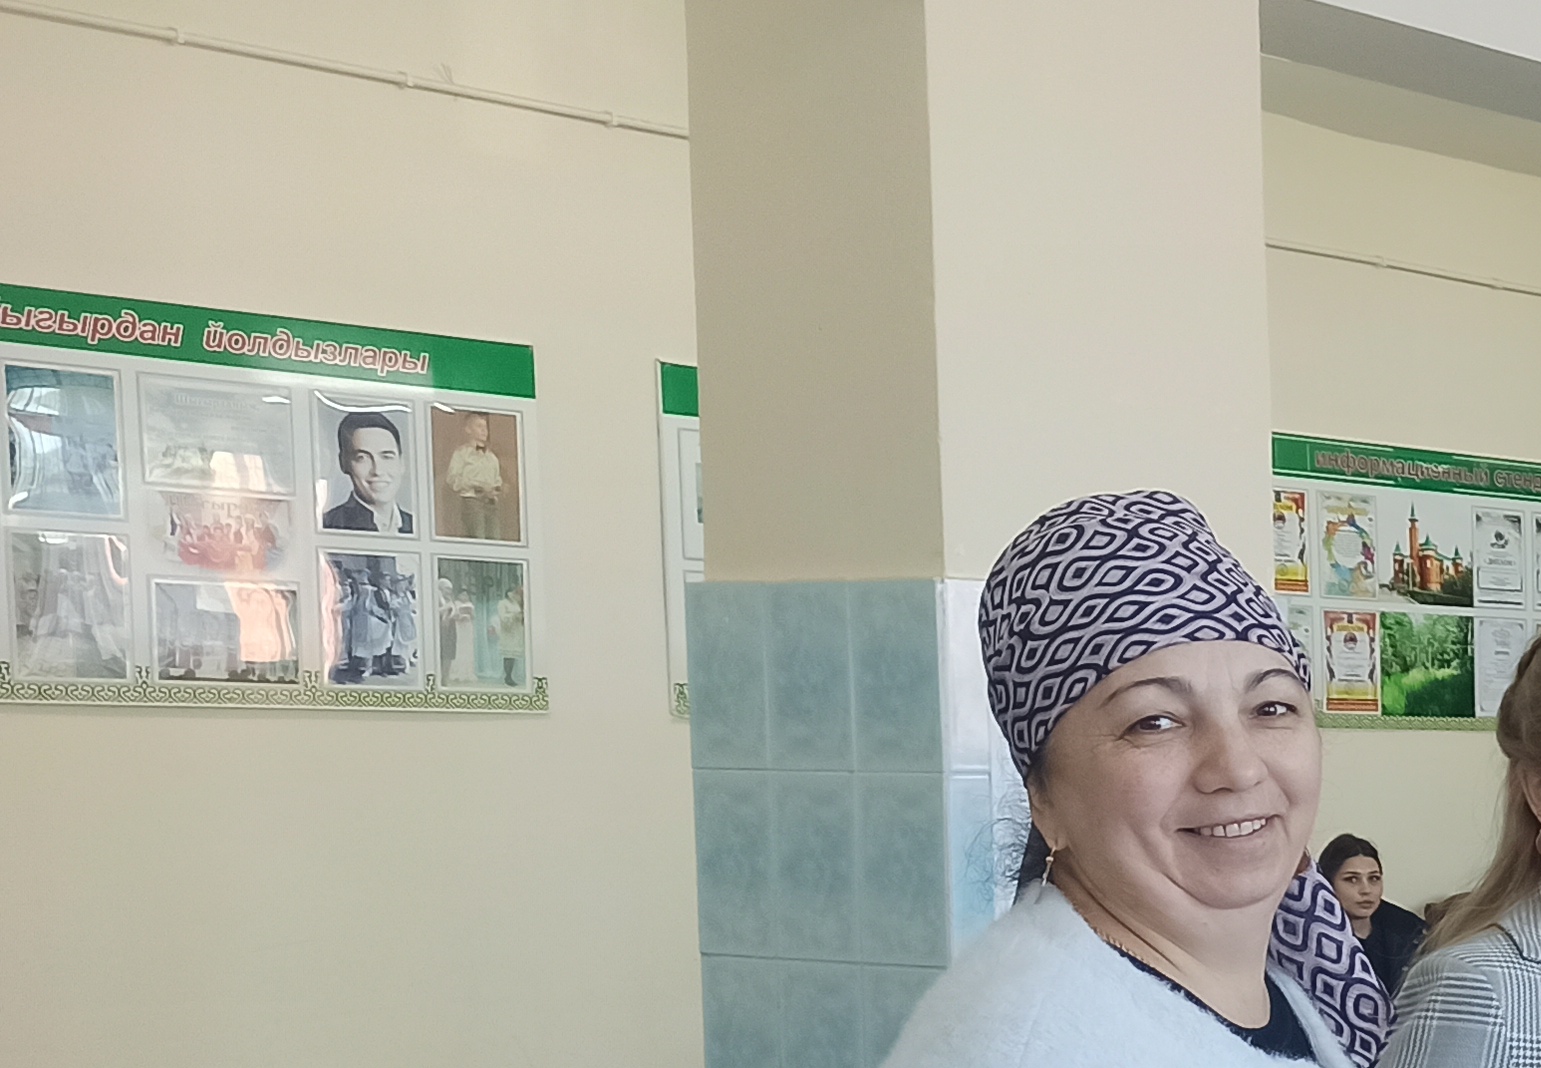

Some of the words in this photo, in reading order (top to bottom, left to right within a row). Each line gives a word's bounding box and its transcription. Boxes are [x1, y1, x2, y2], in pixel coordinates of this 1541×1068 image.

[0, 300, 184, 347] ыгырдан
[202, 321, 431, 376] йолдызлары
[1313, 448, 1490, 486] информационный
